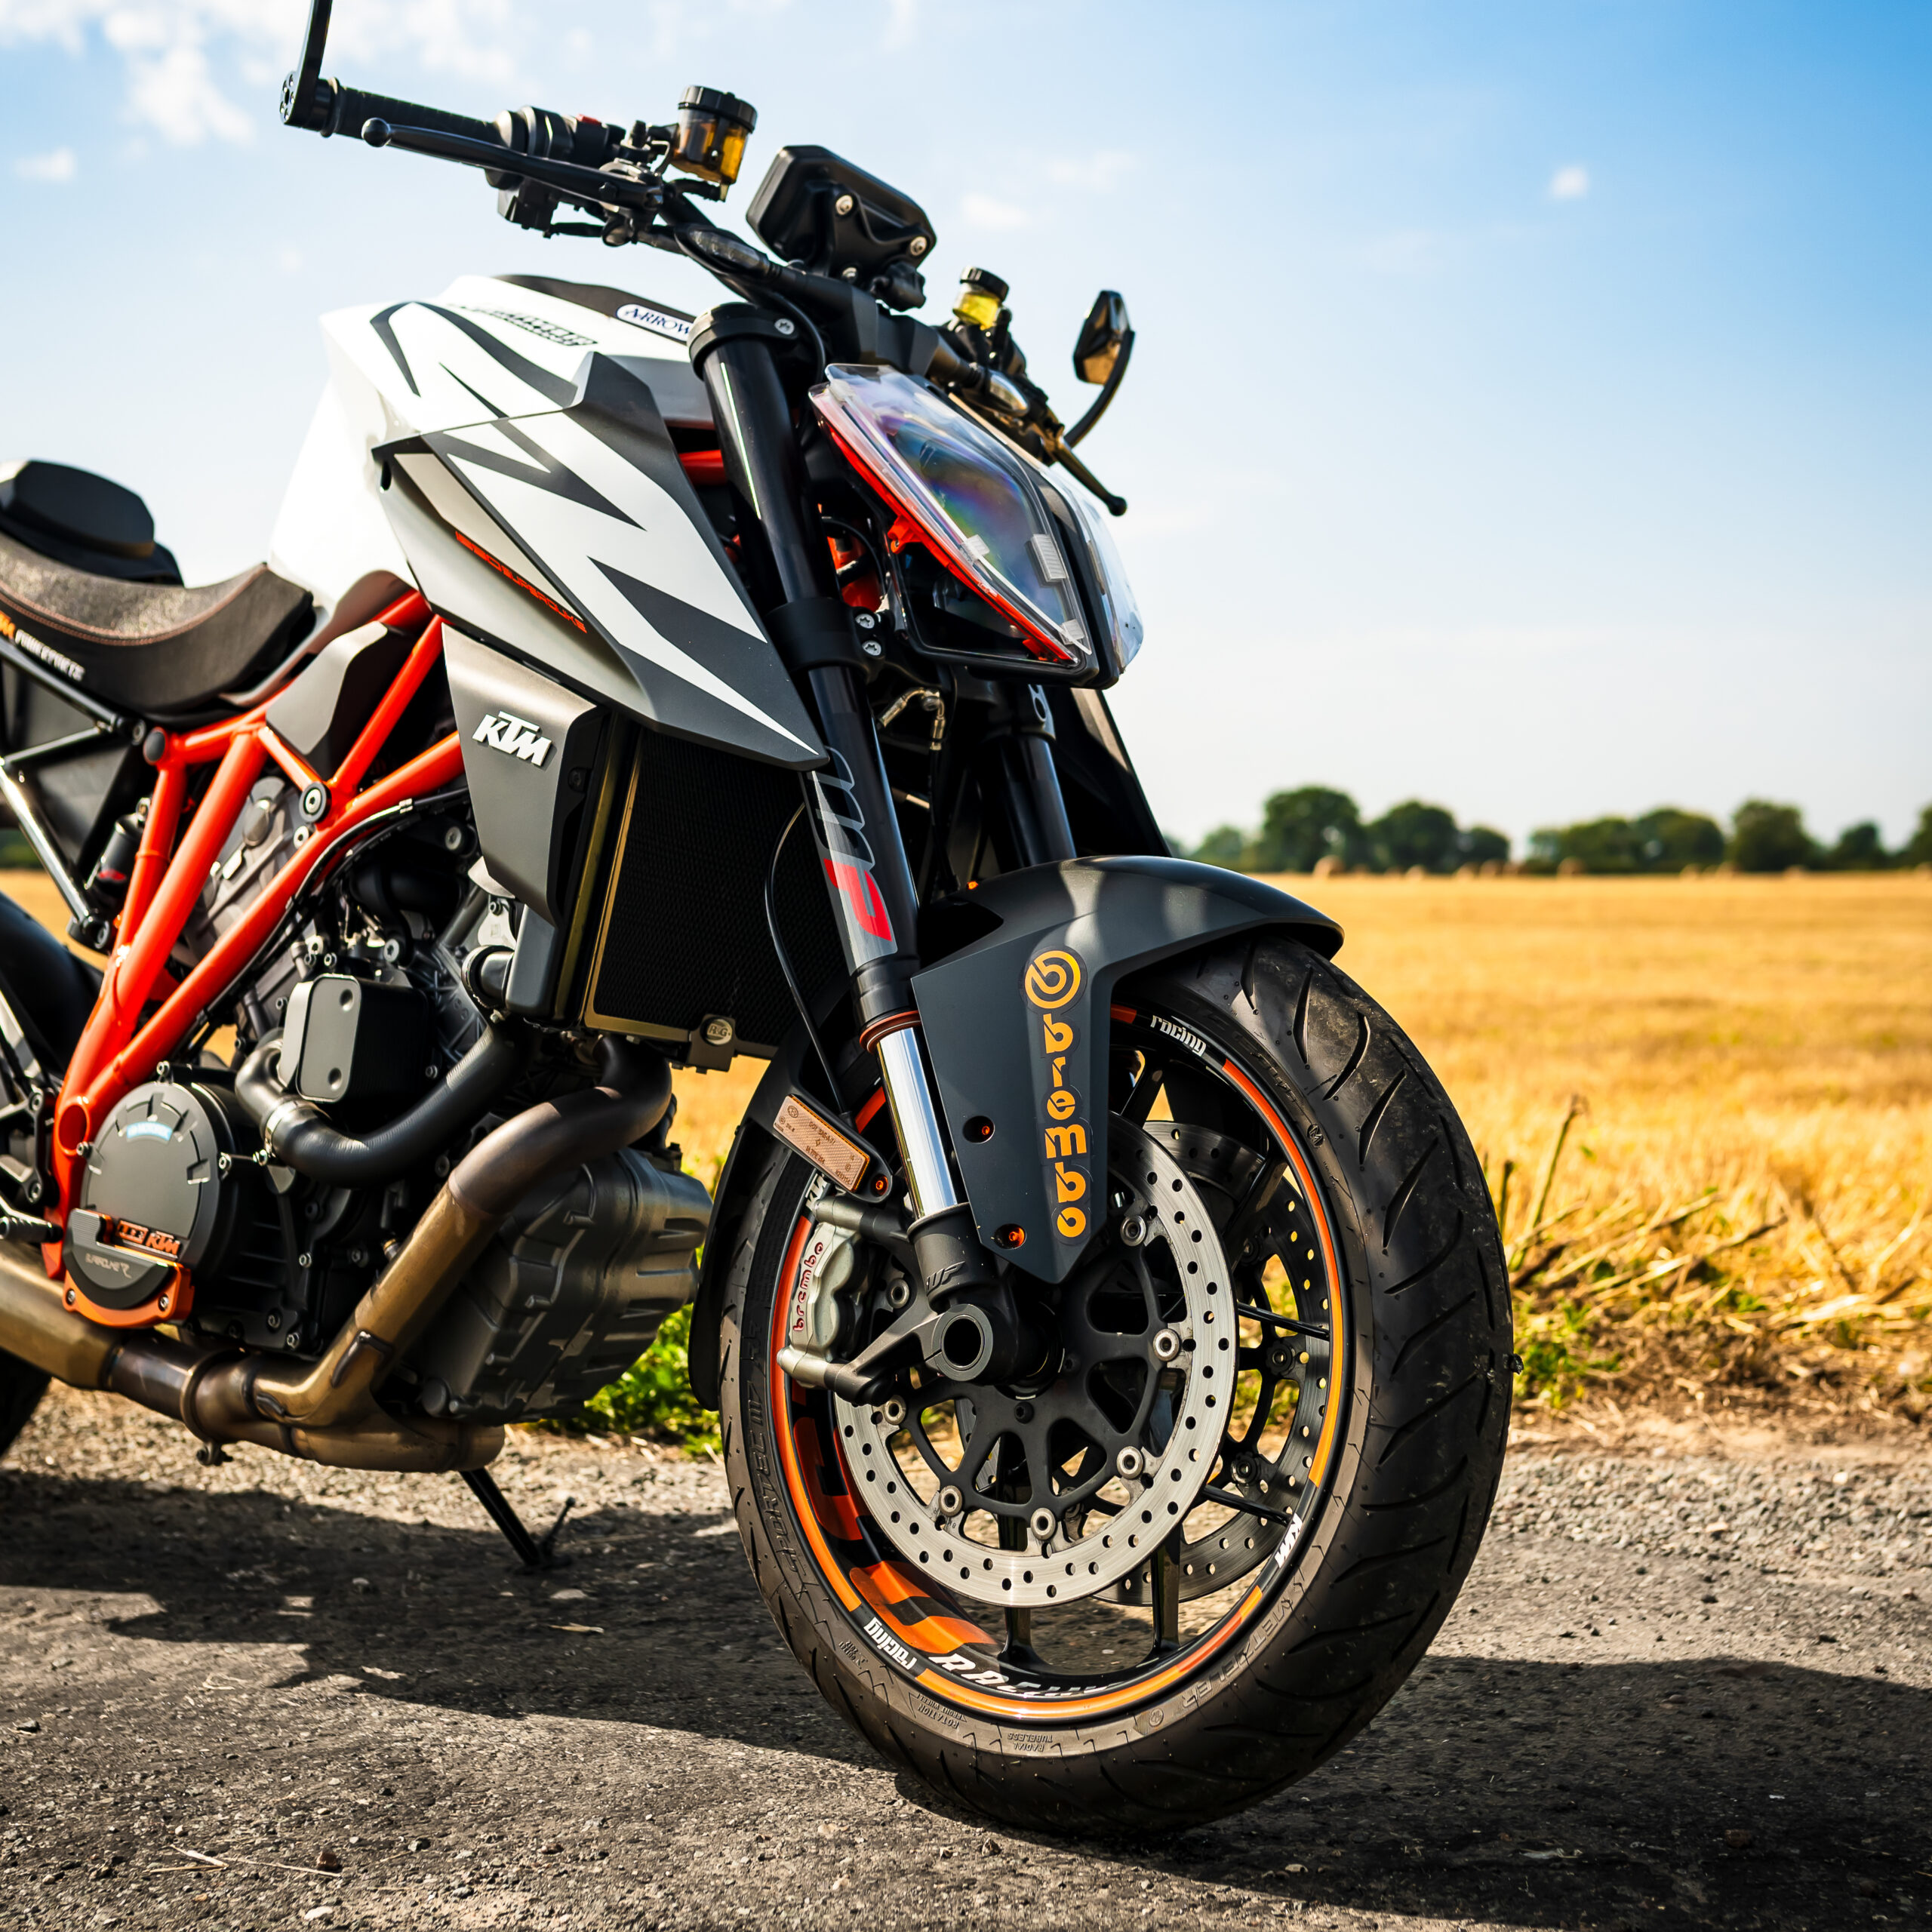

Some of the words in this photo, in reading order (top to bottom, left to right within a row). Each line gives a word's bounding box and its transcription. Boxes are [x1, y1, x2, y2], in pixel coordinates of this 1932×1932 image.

[472, 710, 552, 767] KTM
[1149, 1014, 1207, 1057] racing
[1042, 1013, 1088, 1238] brembo
[146, 1230, 181, 1256] KTM
[792, 1241, 824, 1332] brembo
[1275, 1512, 1303, 1569] KTM
[863, 1616, 918, 1670] racing
[1182, 1597, 1294, 1708] METZELER
[917, 1703, 960, 1730] ROTATION
[1007, 1732, 1054, 1743] TUBELESS
[1014, 1742, 1045, 1753] RADIAL
